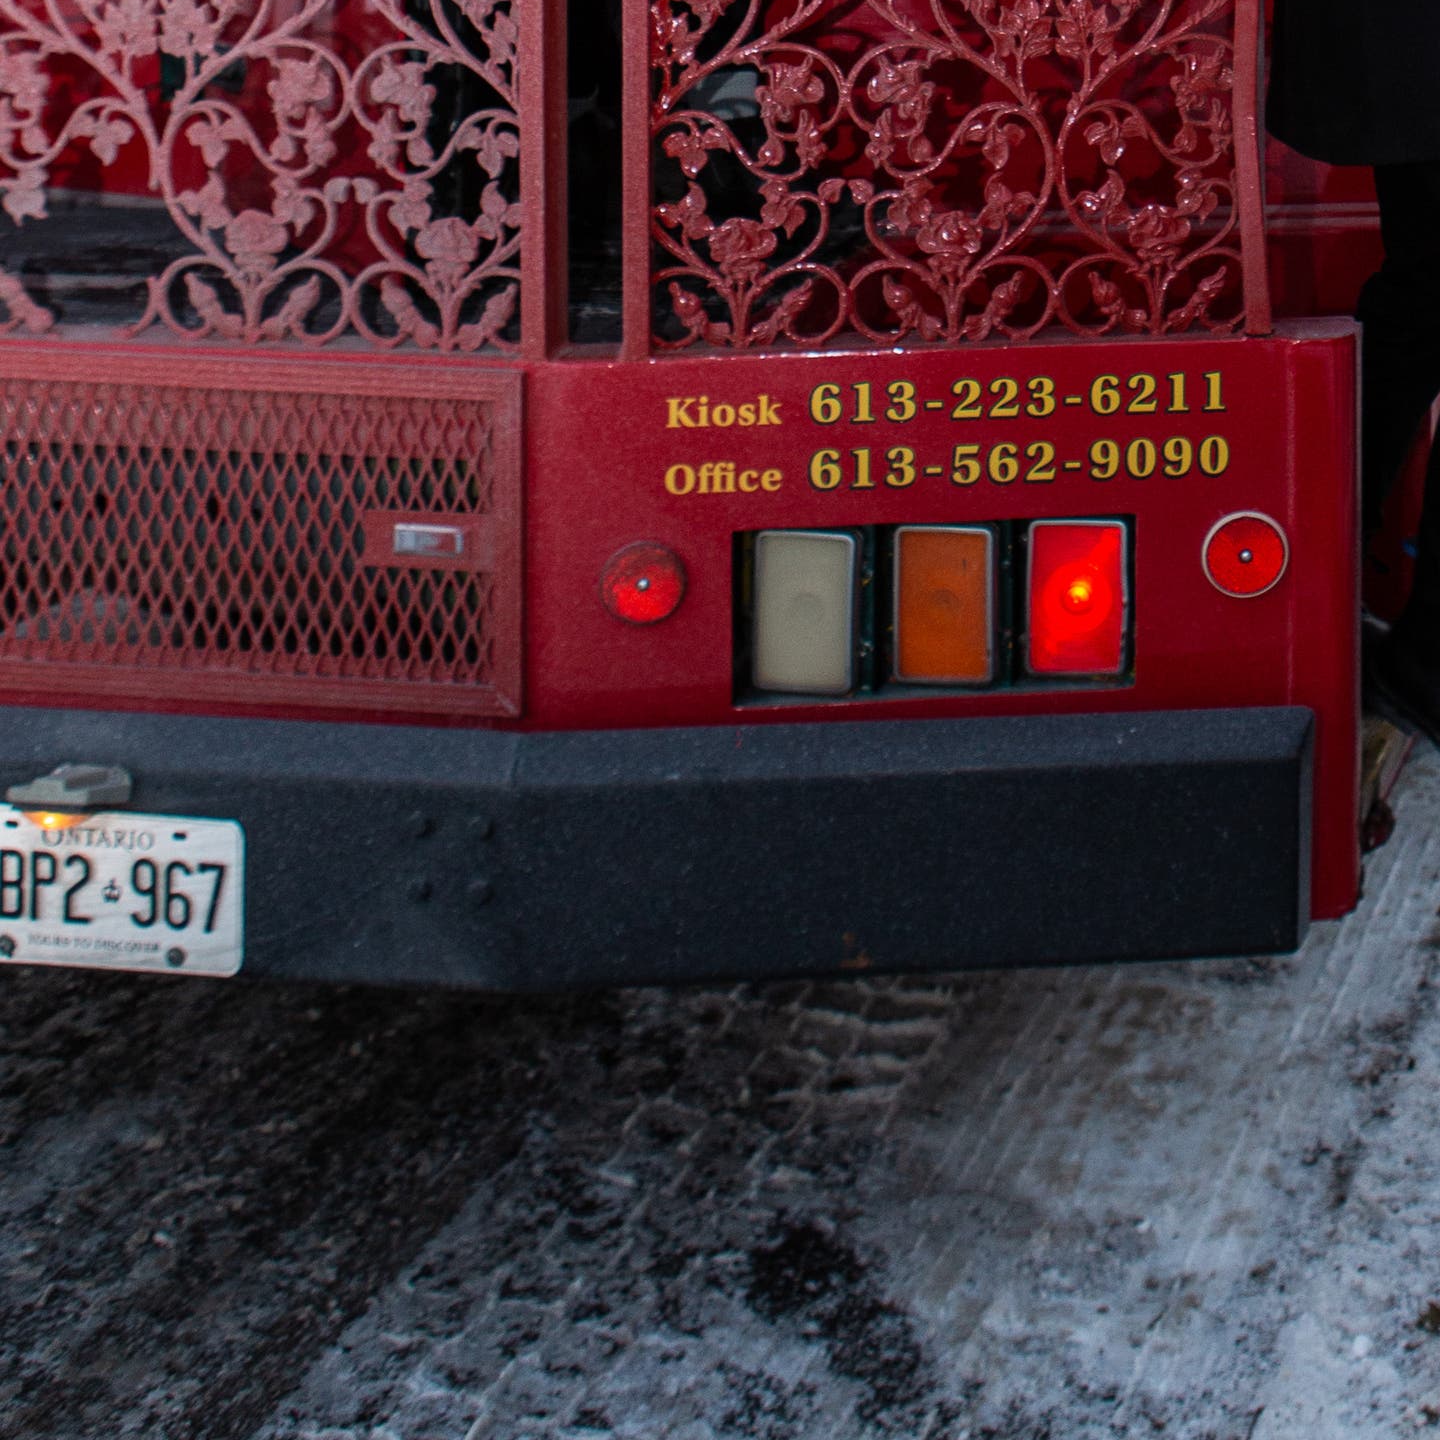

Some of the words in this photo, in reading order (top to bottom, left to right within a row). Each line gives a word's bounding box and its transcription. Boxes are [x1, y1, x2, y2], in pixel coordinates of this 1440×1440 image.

[665, 395, 783, 428] Kiosk
[808, 370, 1228, 424] 613-223-6211
[664, 462, 783, 496] Office
[808, 435, 1231, 491] 613-562-9090
[41, 828, 155, 852] ONTARIO
[130, 858, 226, 933] 967
